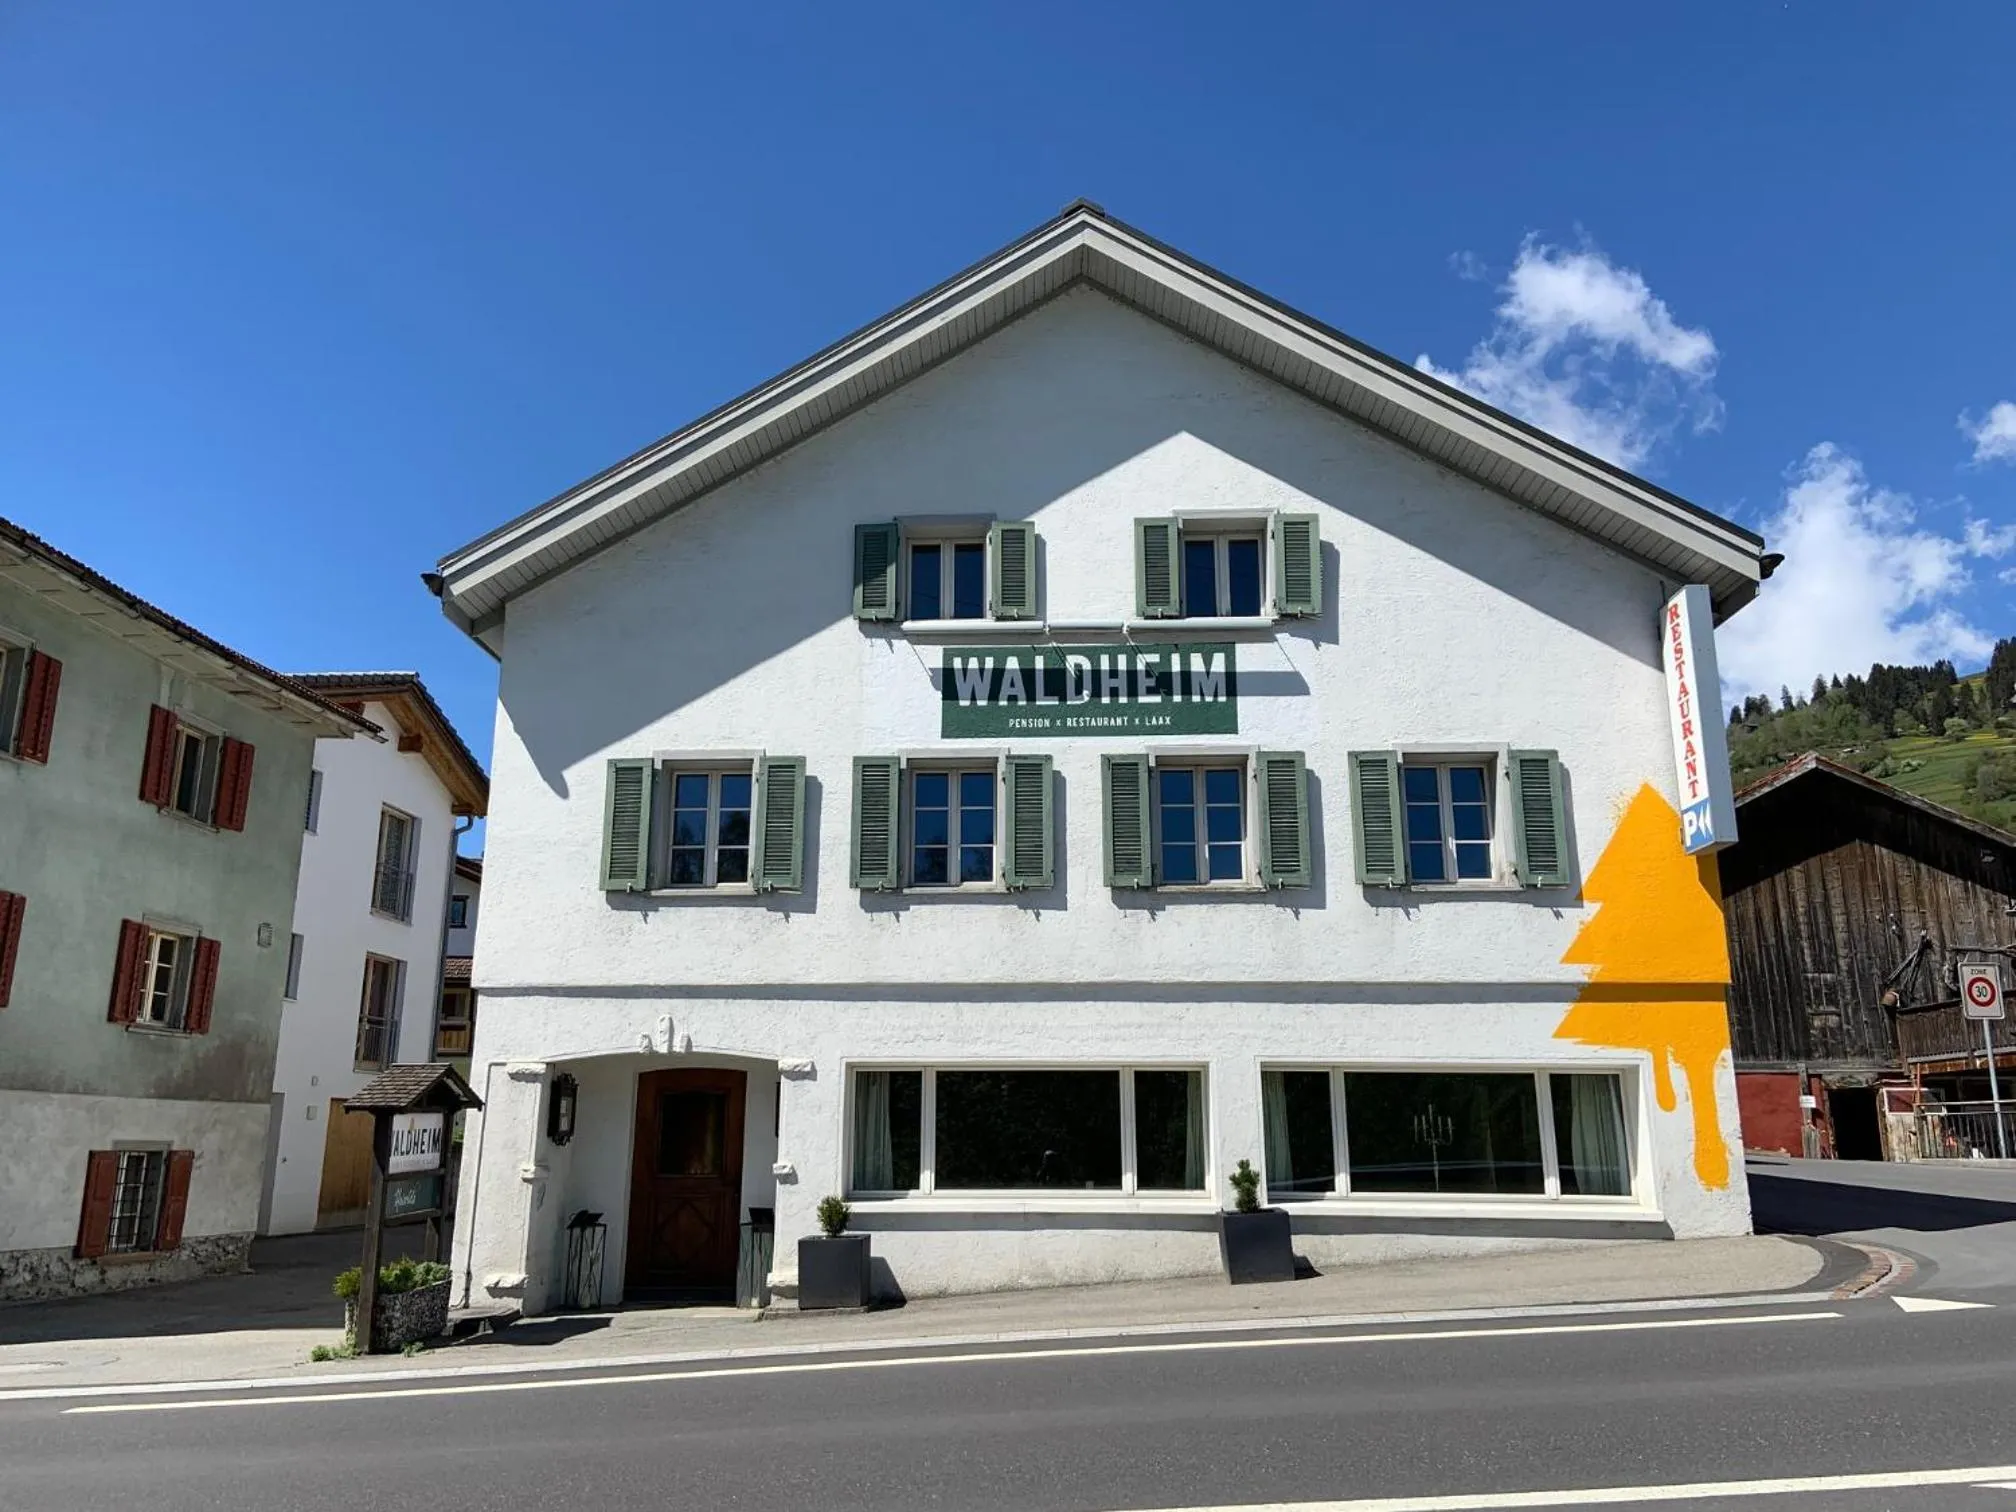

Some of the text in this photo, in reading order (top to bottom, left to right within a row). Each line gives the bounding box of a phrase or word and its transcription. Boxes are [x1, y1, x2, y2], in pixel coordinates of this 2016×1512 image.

[953, 652, 1227, 707] WALDHEIM
[1667, 602, 1699, 800] RESTAURANT
[1008, 717, 1050, 728] PENSION
[1066, 716, 1129, 728] RESTAURANT
[1145, 715, 1172, 726] LAAX
[1683, 810, 1698, 847] P
[1975, 985, 1988, 998] 30
[393, 1127, 442, 1157] ALDHEIM
